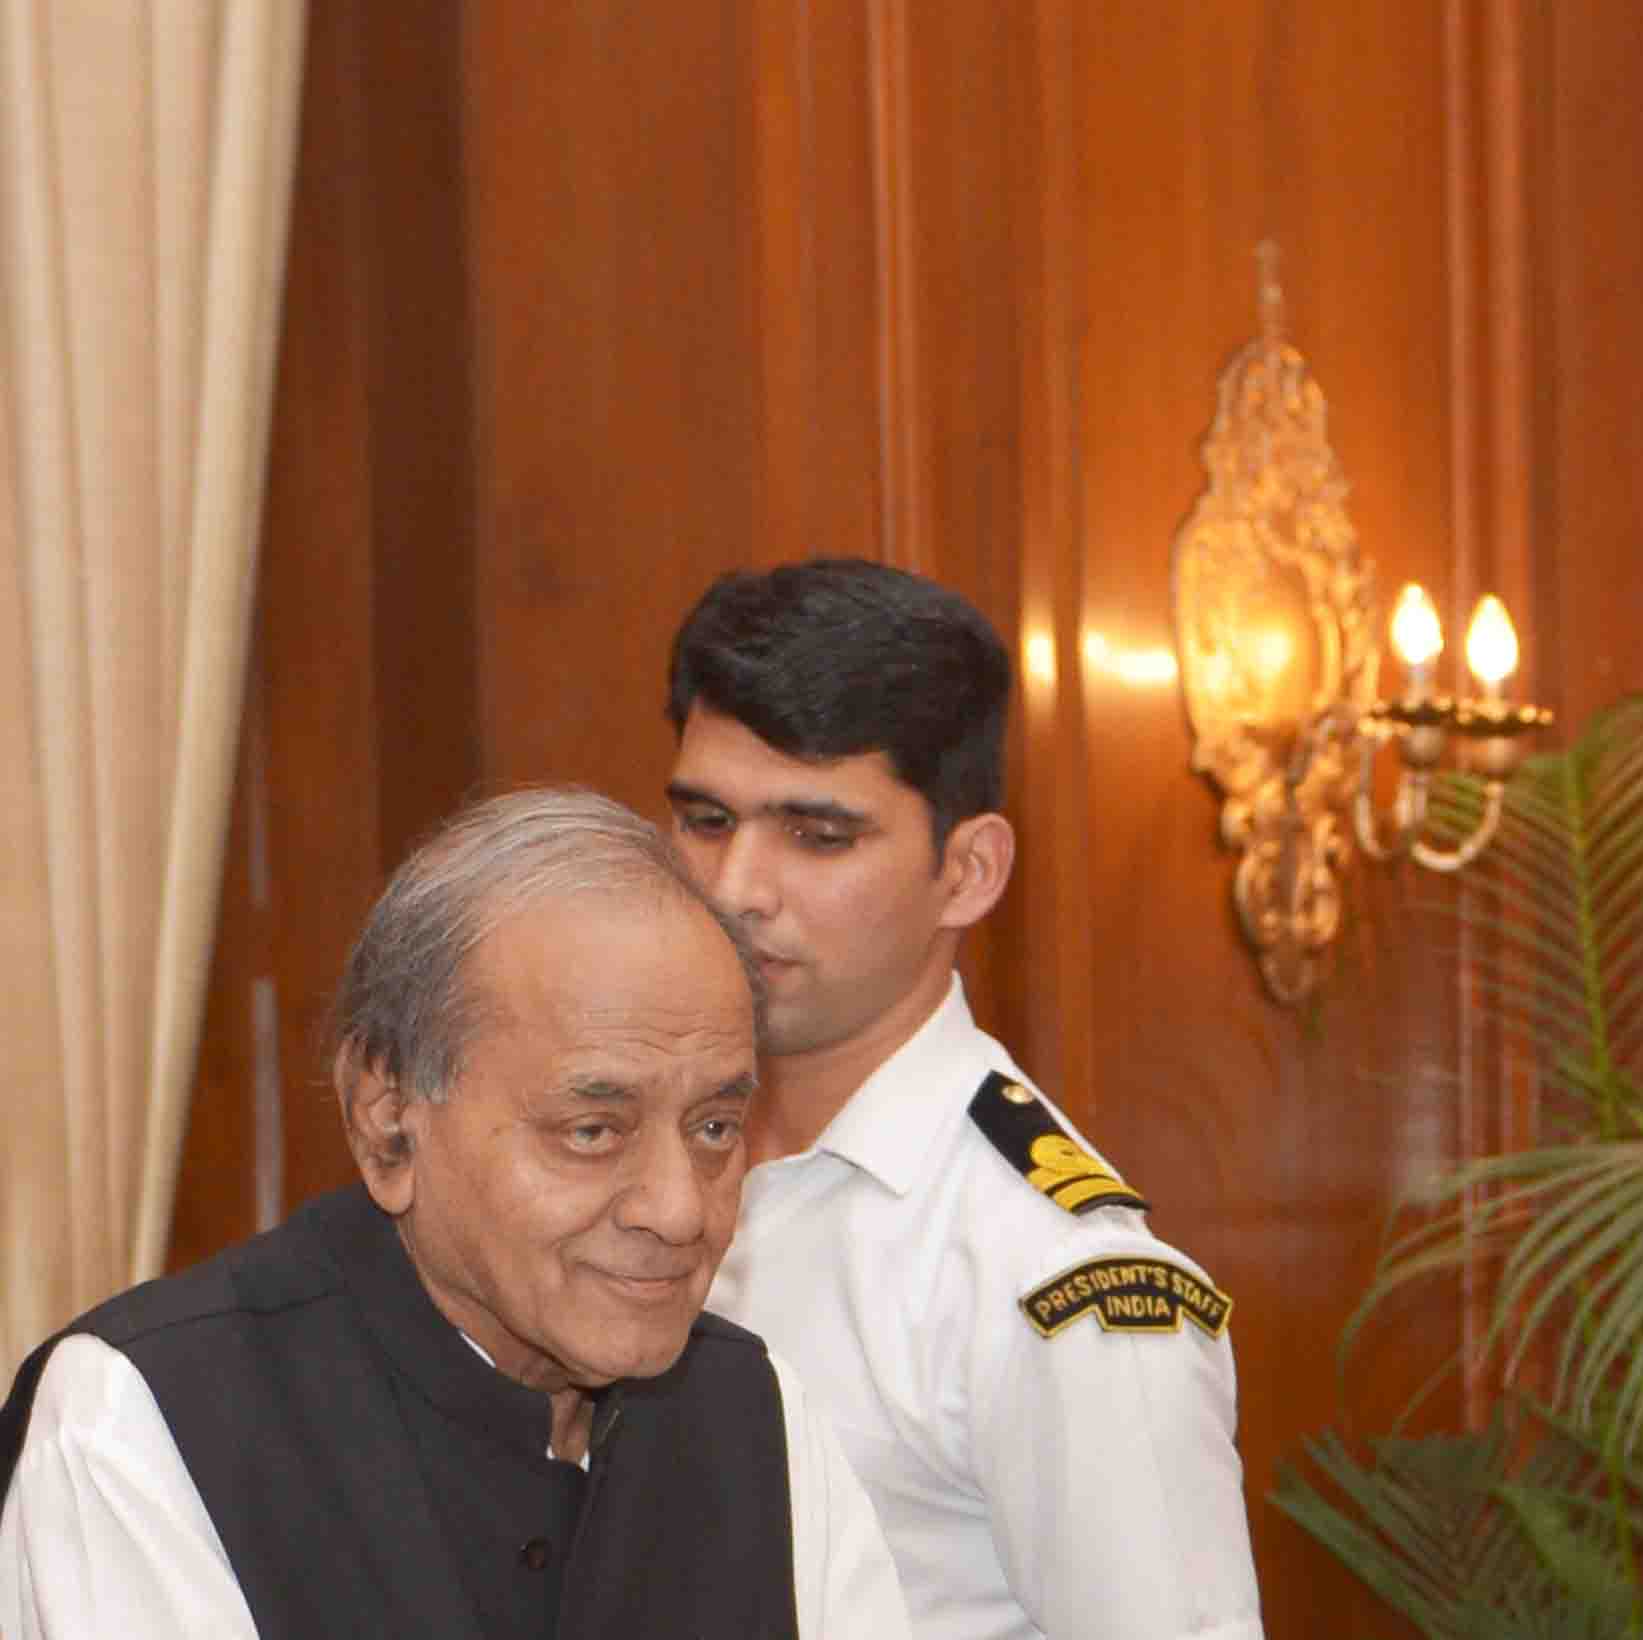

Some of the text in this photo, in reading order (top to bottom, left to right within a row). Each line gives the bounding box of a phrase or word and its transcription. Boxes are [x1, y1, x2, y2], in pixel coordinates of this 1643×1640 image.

[1035, 1264, 1224, 1322] PRESIDENT'S STAFF
[1106, 1294, 1170, 1318] INDIA
